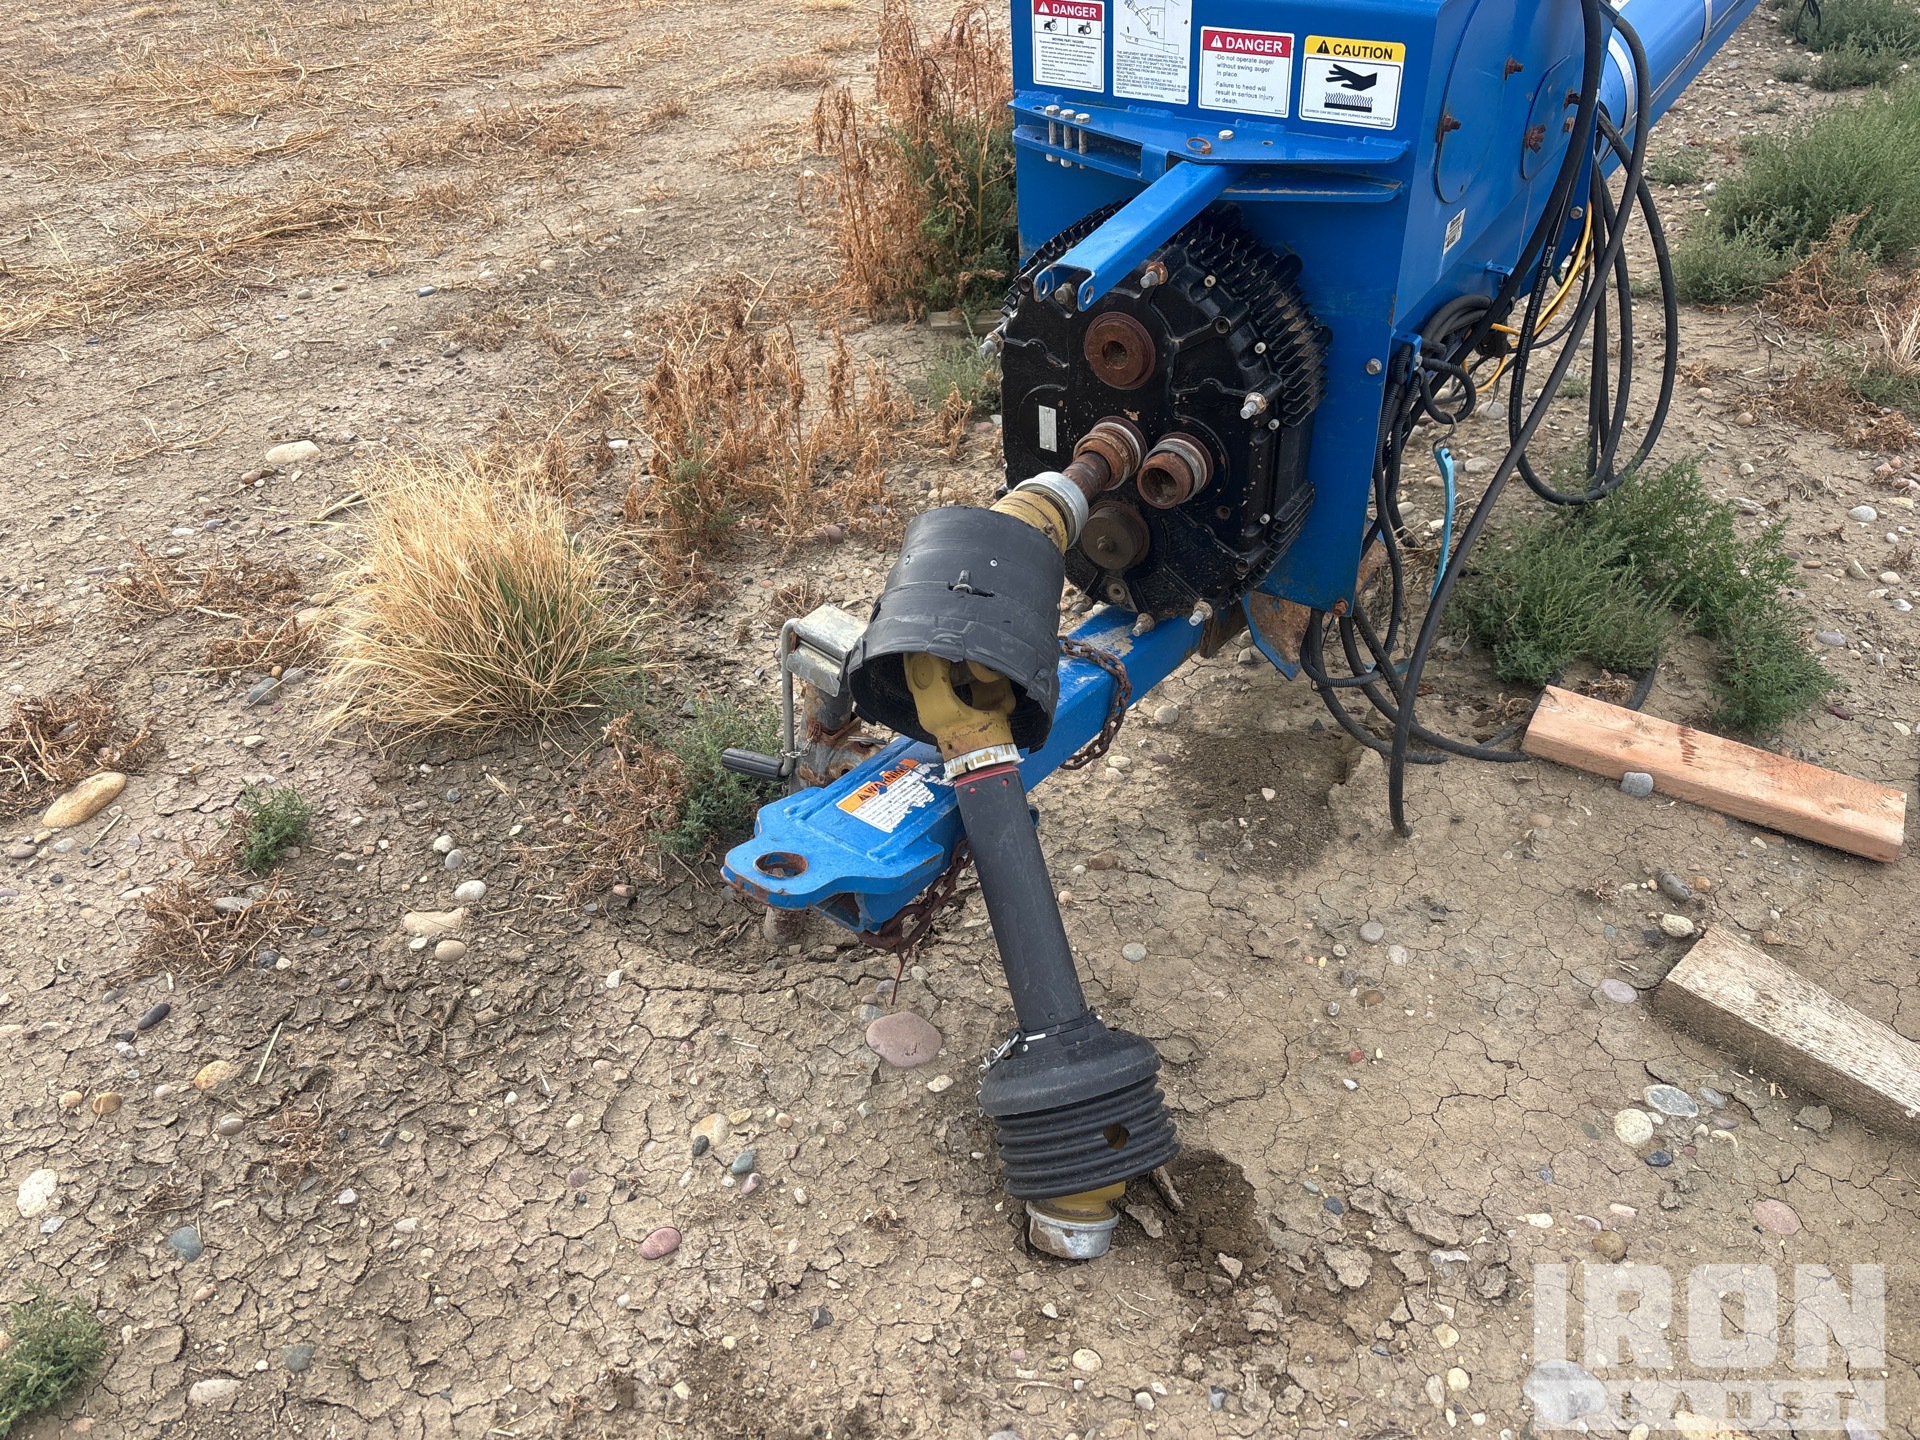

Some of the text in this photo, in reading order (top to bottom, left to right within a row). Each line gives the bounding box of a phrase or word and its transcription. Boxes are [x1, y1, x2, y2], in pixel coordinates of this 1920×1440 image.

[1052, 3, 1097, 18] DANGER
[1226, 36, 1283, 54] DANGER
[1333, 43, 1393, 60] CAUTION
[1236, 57, 1257, 65] operate
[1237, 65, 1256, 73] swing
[1259, 93, 1275, 101] injury
